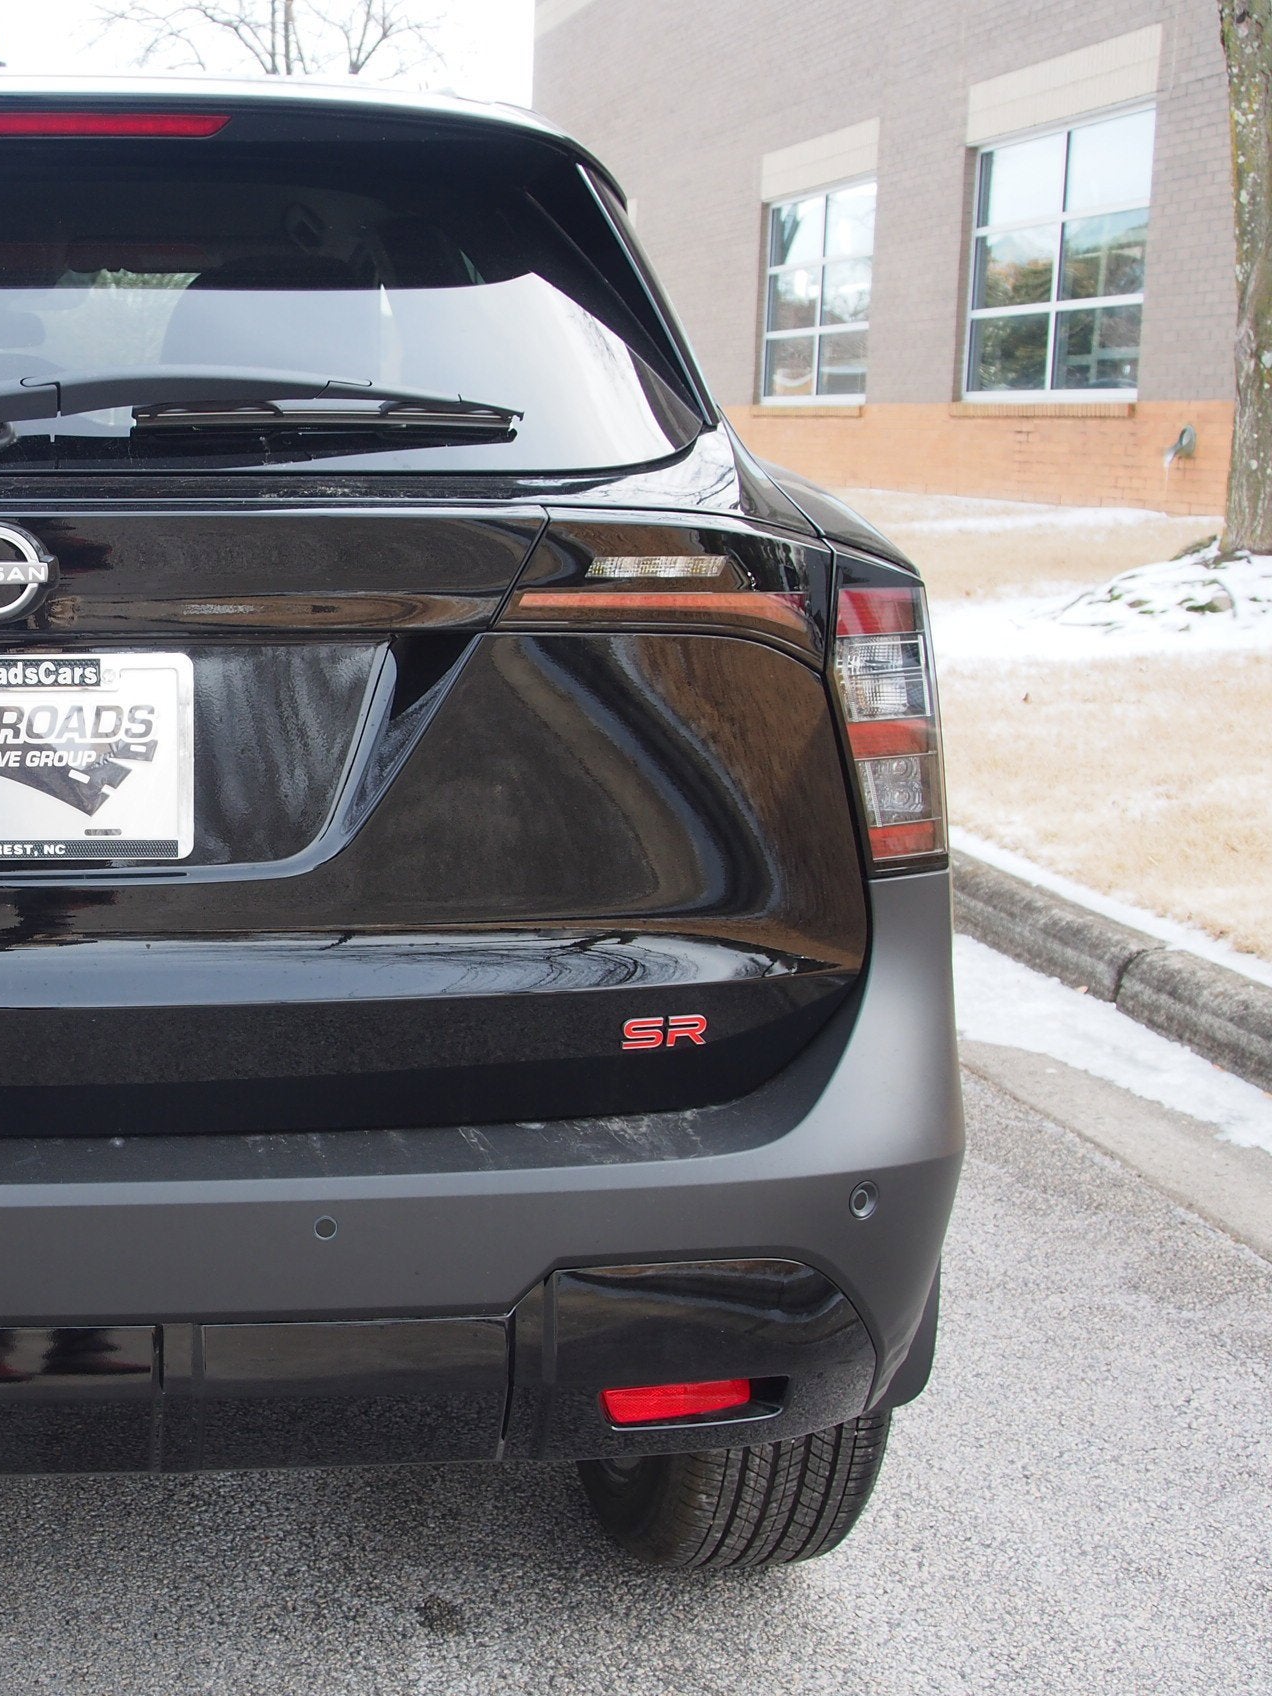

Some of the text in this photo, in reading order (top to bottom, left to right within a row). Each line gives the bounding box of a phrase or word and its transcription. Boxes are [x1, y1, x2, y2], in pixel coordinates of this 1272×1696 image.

[25, 750, 97, 768] GROUP
[43, 844, 67, 855] NC
[621, 1013, 708, 1050] SR
